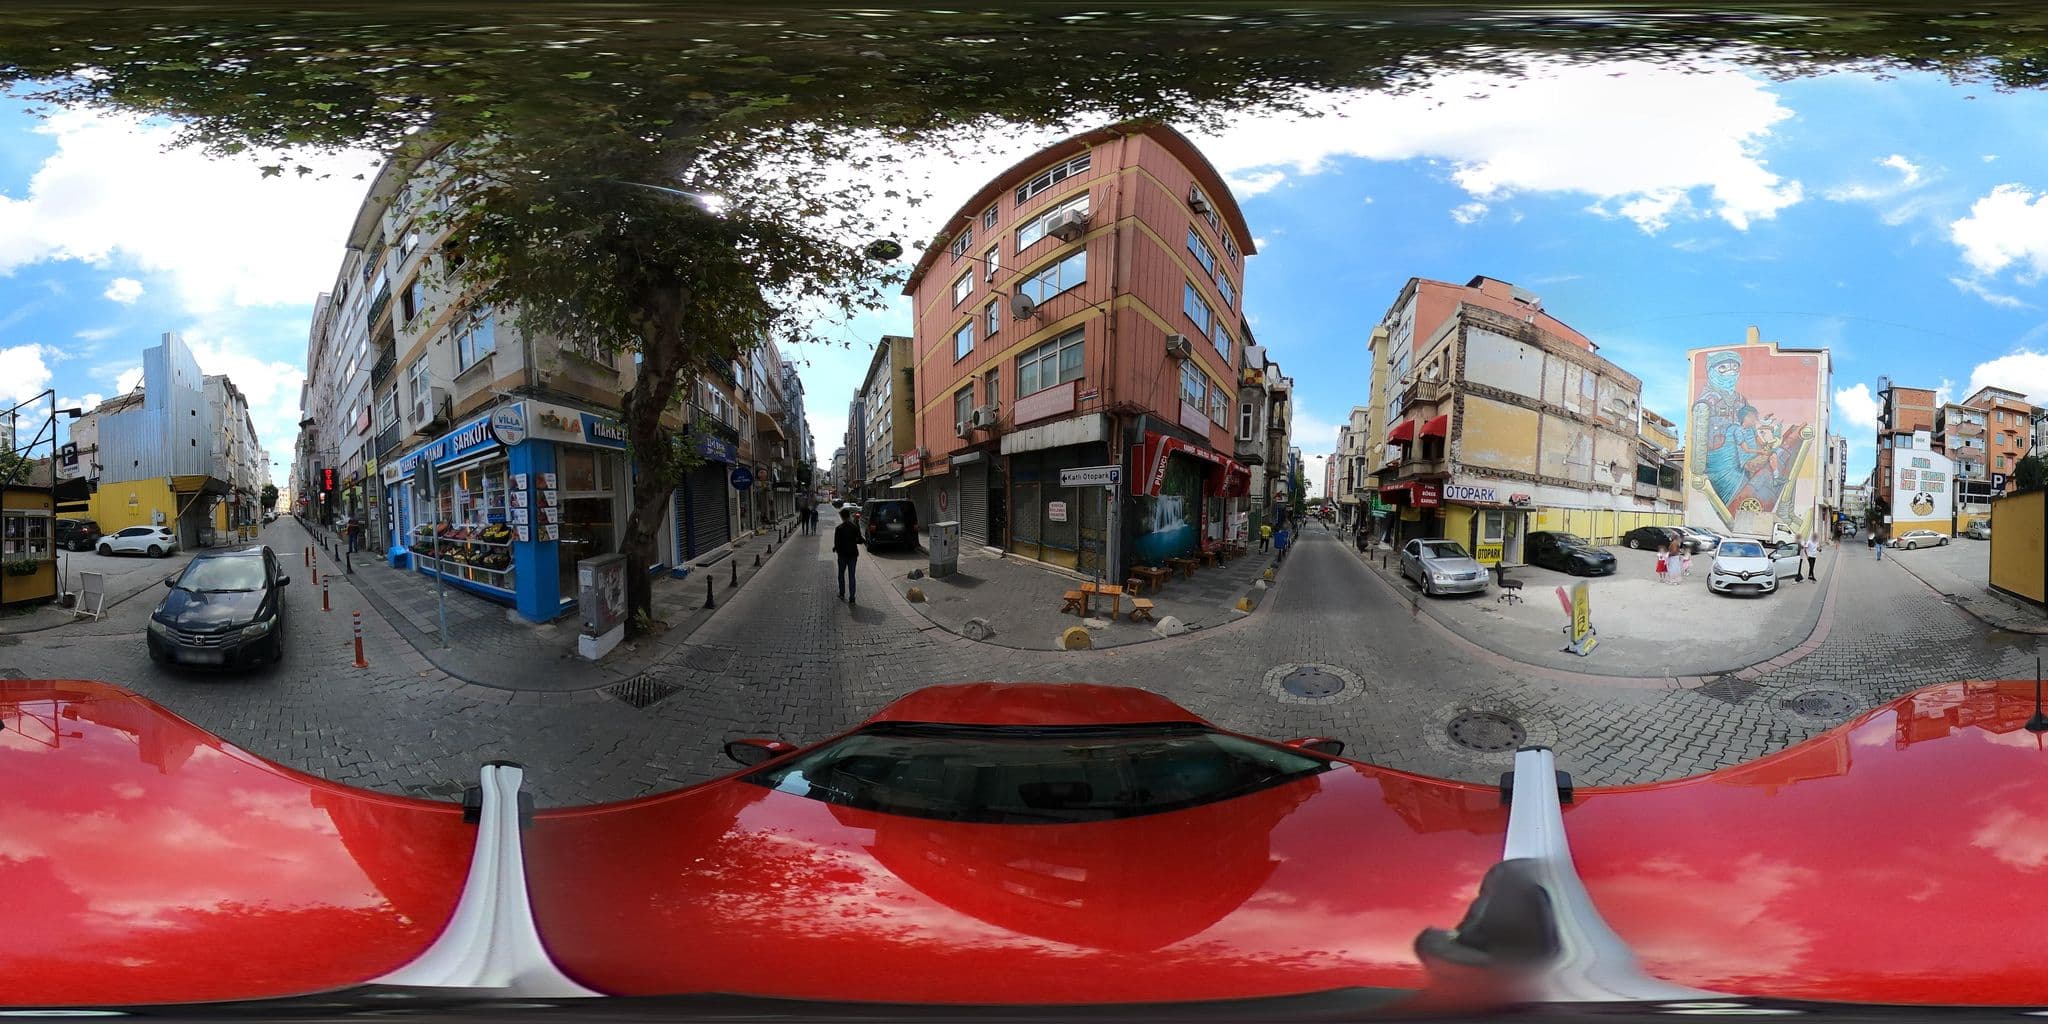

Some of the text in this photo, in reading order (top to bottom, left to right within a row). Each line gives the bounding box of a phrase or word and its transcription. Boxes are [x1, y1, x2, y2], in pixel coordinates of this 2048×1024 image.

[1083, 473, 1109, 481] Otopark
[1994, 474, 2004, 489] P
[1446, 486, 1494, 500] OTOPARK
[1478, 548, 1501, 560] OTOPARK
